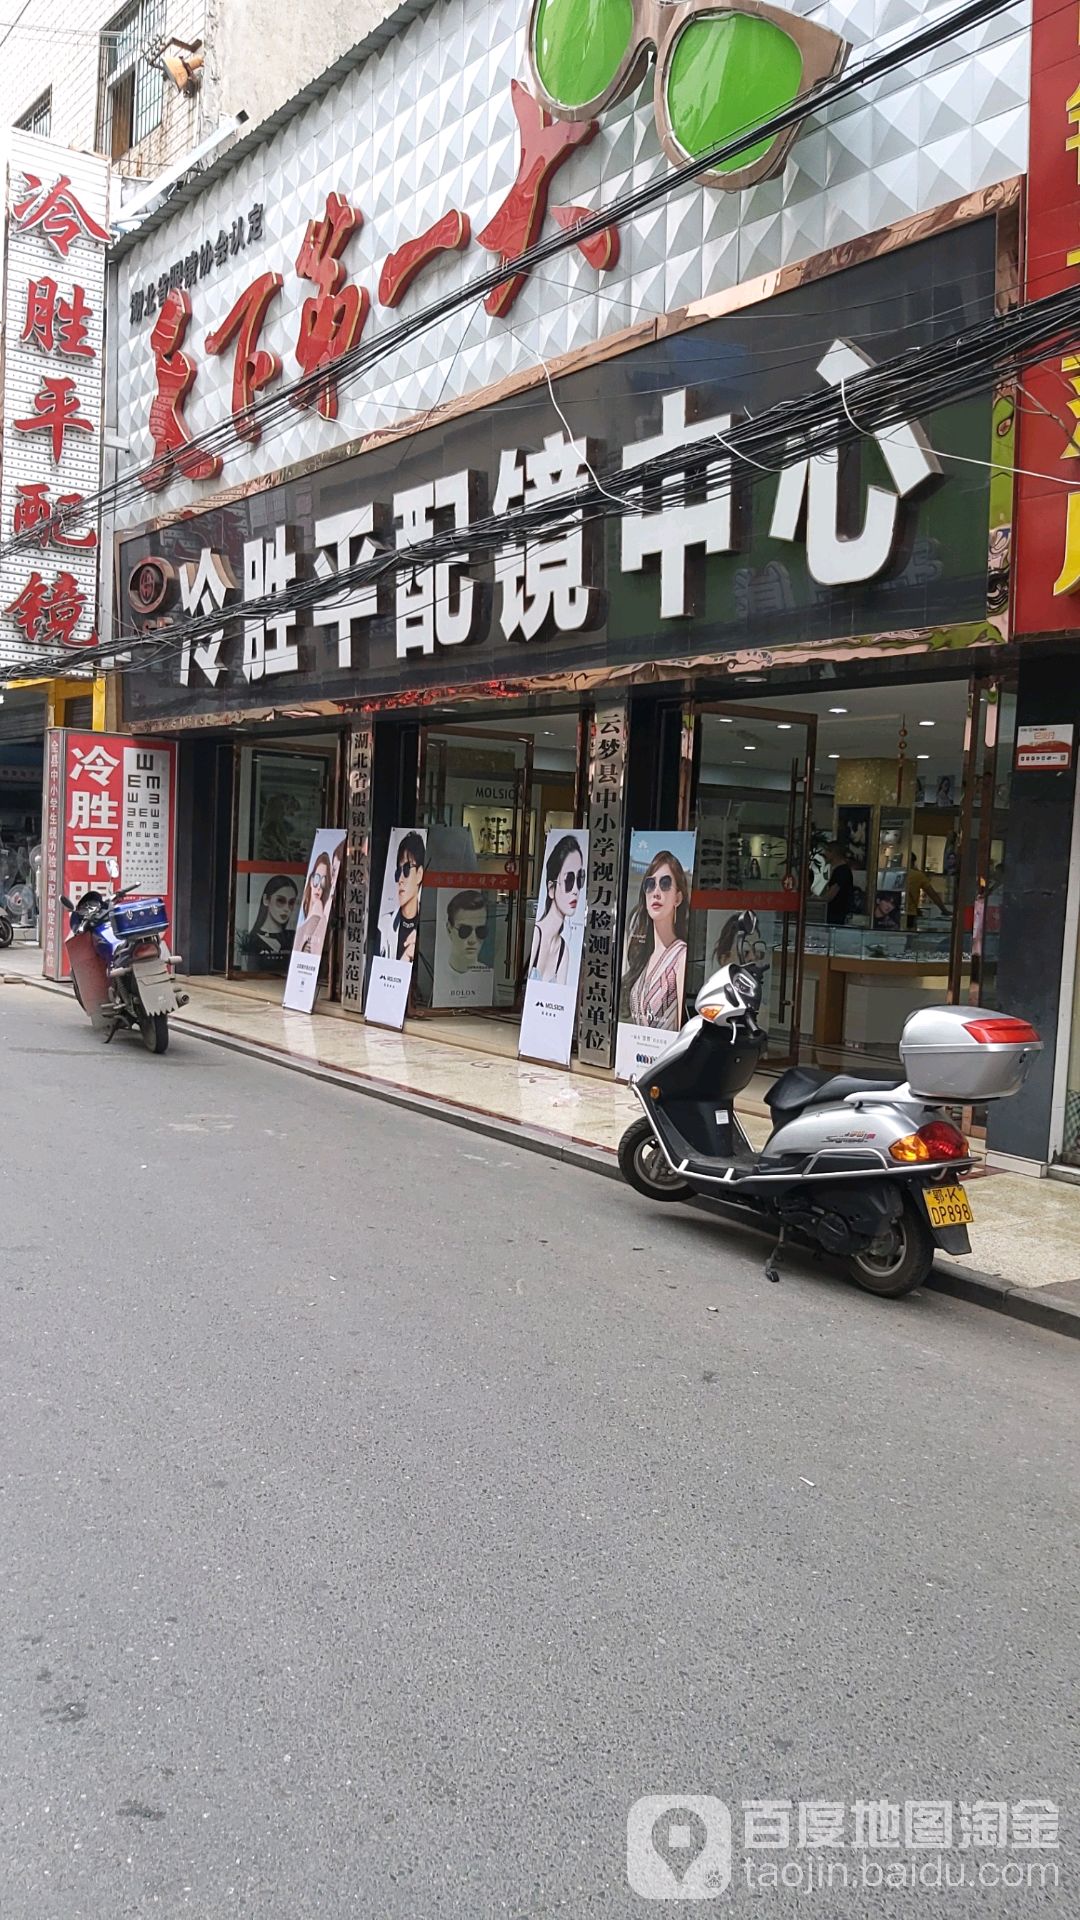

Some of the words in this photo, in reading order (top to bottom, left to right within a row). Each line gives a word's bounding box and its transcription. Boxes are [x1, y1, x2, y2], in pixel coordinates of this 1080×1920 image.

[4, 171, 112, 648] 冷胜平配镜
[178, 337, 938, 685] 冷胜平配镜中心
[345, 732, 369, 1001] 湖北省眼镜行业验光配镜示范店
[475, 786, 519, 801] MOLSIO
[584, 712, 621, 1051] 云梦县中小学视力检测定点单位
[931, 1205, 971, 1225] DP898
